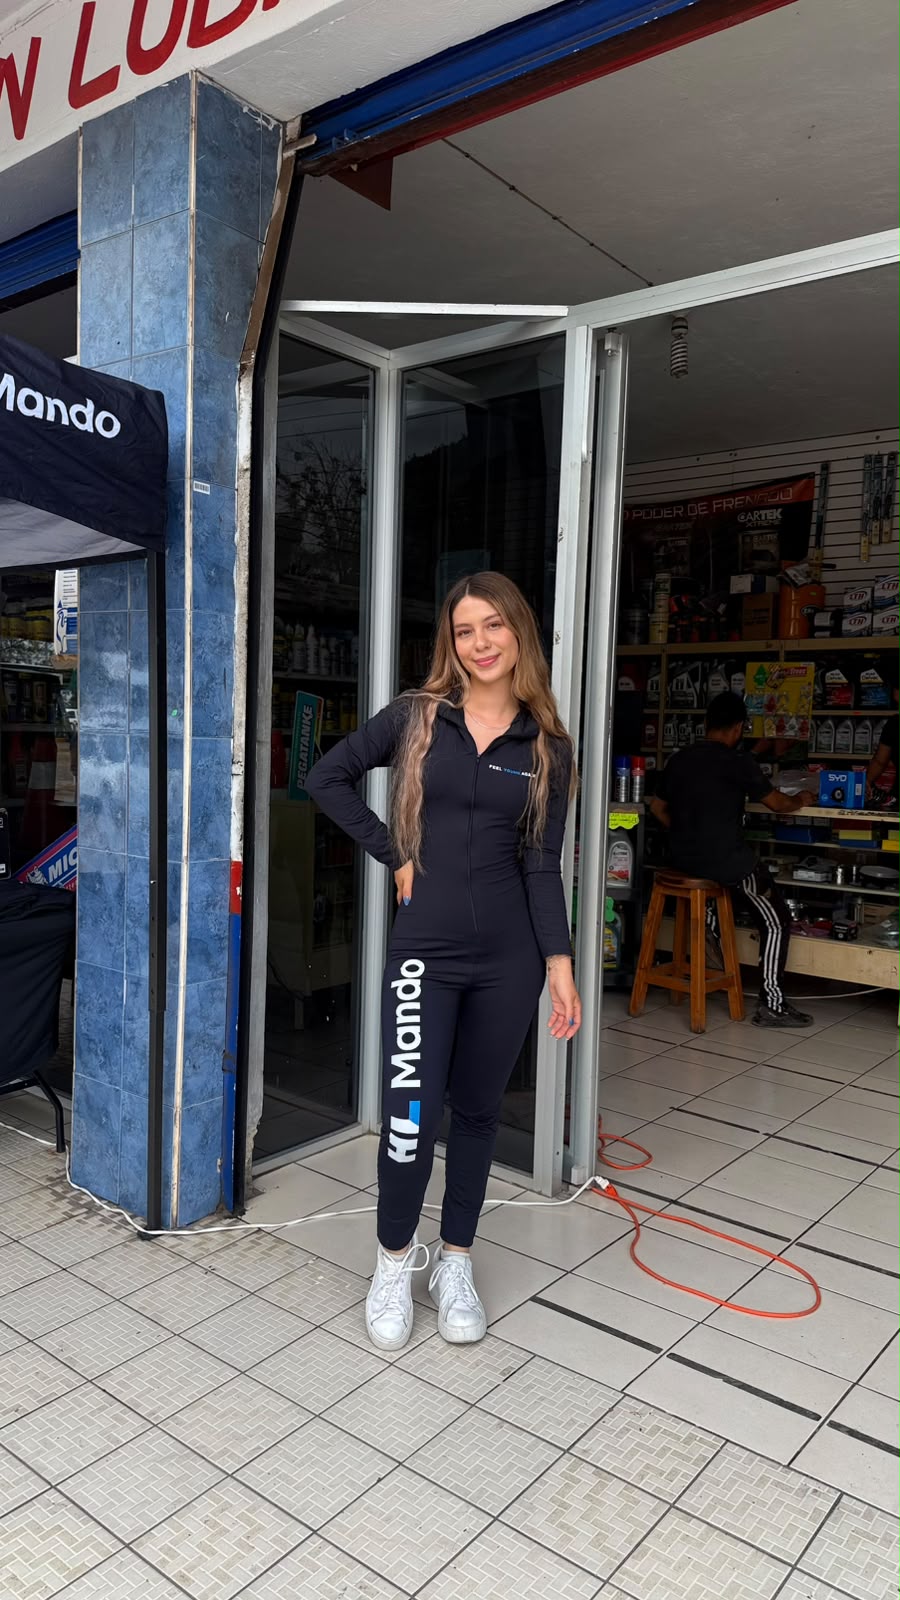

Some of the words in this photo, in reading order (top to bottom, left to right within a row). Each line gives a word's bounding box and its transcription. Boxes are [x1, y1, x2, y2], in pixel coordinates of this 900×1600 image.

[632, 505, 684, 520] PODER
[687, 502, 709, 516] DE
[737, 508, 784, 522] CARTEK
[881, 582, 899, 590] LTH
[848, 618, 864, 626] LTH
[881, 616, 897, 624] LTH
[296, 704, 314, 791] PEGATANKE
[488, 763, 503, 772] FEEL
[828, 773, 848, 782] SYD
[390, 958, 426, 1089] Mando
